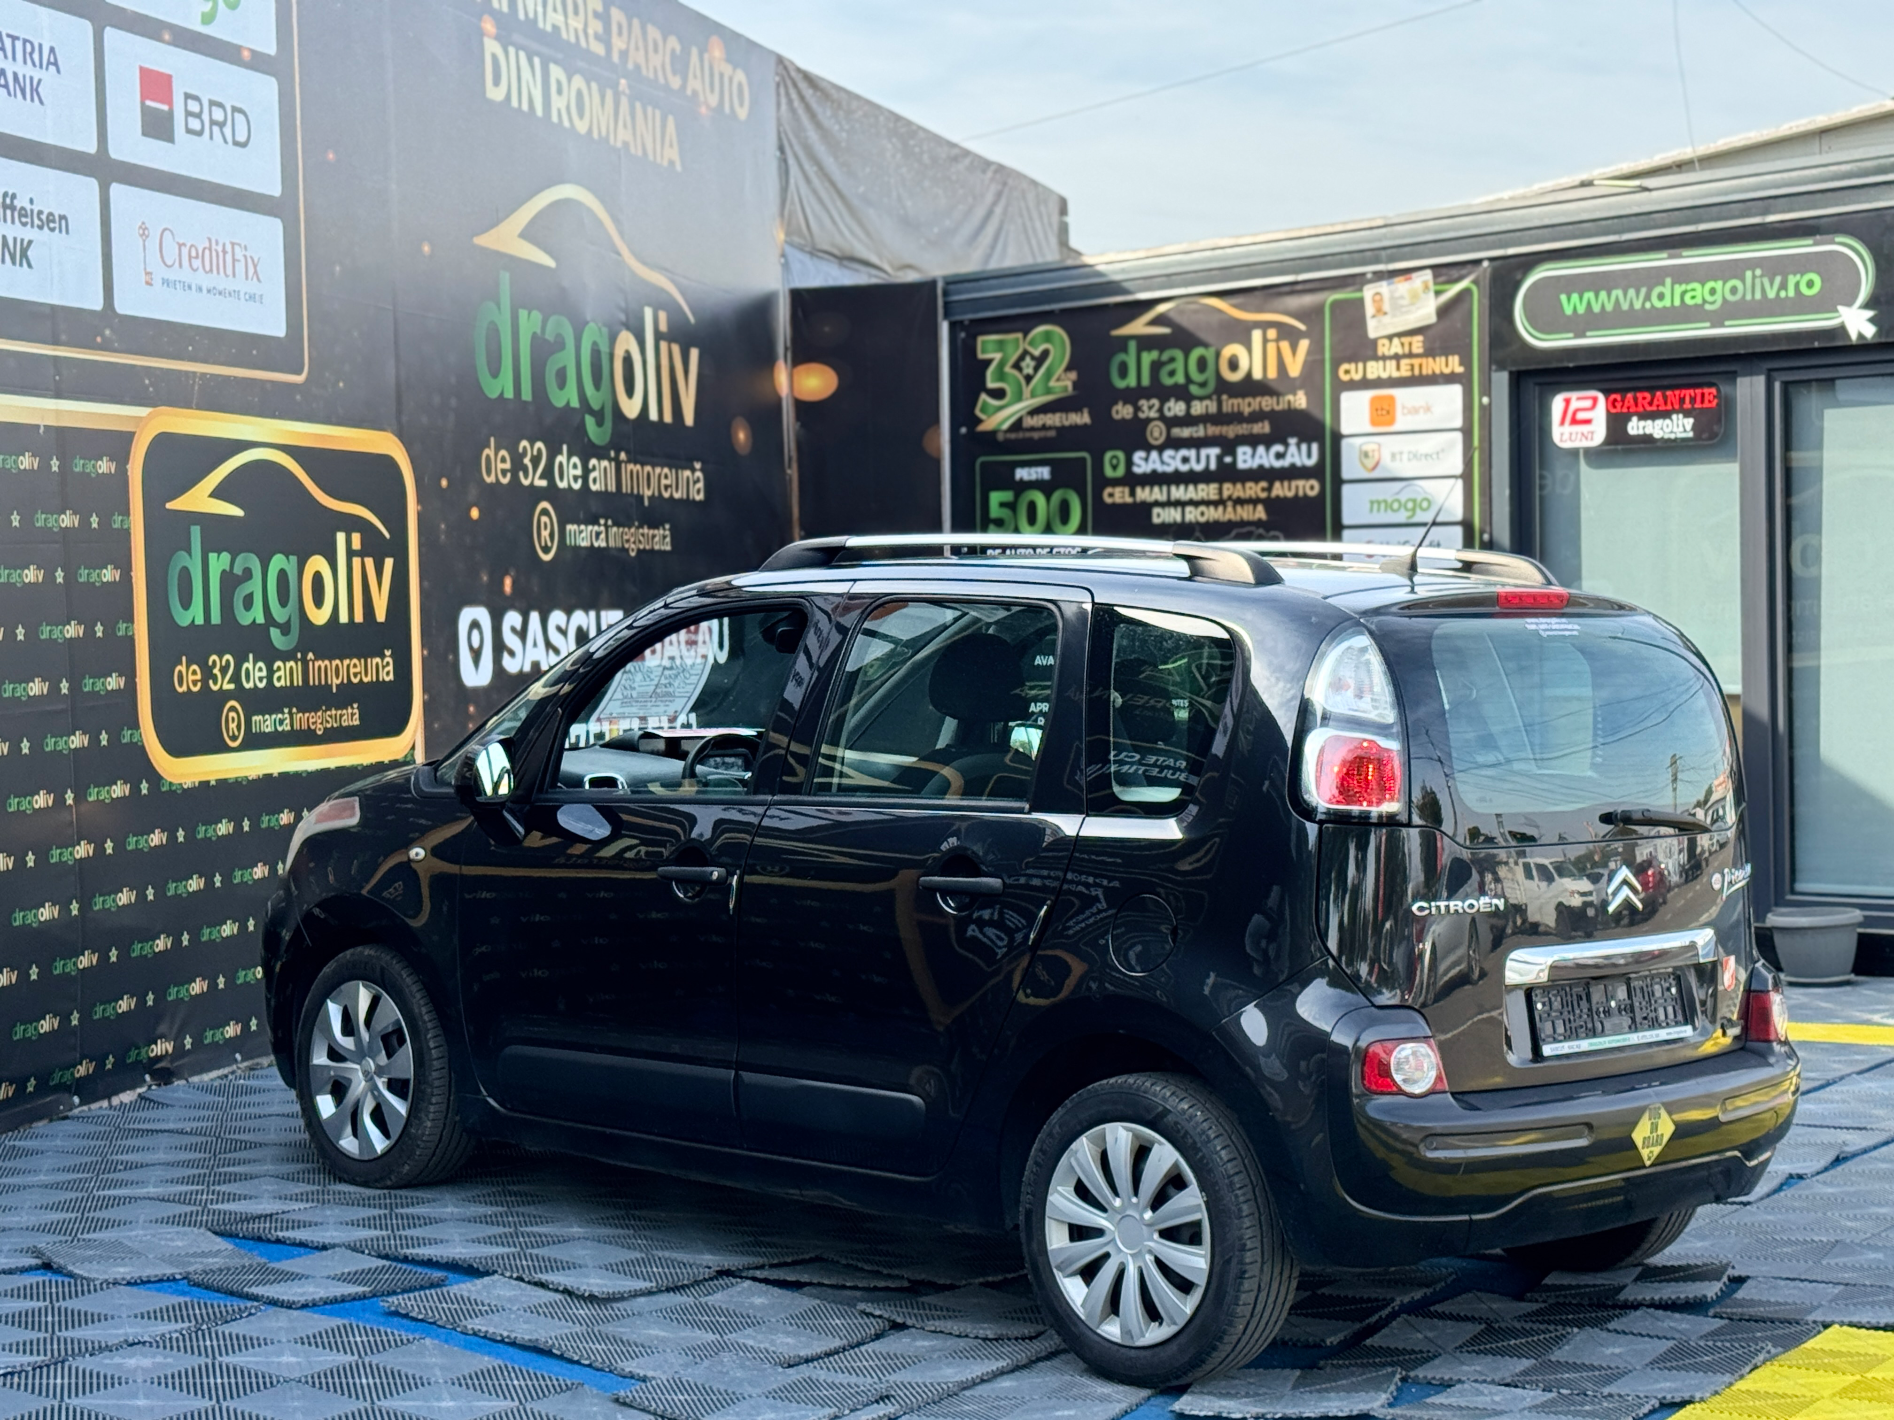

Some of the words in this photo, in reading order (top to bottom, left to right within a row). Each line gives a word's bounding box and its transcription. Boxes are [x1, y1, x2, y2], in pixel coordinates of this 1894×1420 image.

[610, 6, 681, 90] PARC
[686, 45, 750, 121] AUTO
[183, 91, 251, 149] BRD
[483, 36, 543, 118] DIN
[549, 78, 682, 173] ROMÂNIA
[159, 227, 262, 284] CreditFix
[161, 277, 192, 292] PRIETEN
[206, 286, 241, 301] MOMENTE
[1560, 268, 1822, 316] www.dragoliv.ro
[474, 270, 700, 446] dragoliv
[1377, 335, 1425, 356] RATE
[974, 324, 1072, 422] 32
[1110, 328, 1310, 396] dragoliv
[1338, 362, 1363, 382] CU
[1365, 355, 1465, 381] BULETINUL
[1111, 400, 1134, 420] de
[1137, 398, 1160, 418] 32
[1163, 398, 1187, 417] de
[1190, 396, 1217, 415] ani
[1221, 390, 1308, 416] împreună
[1401, 401, 1433, 416] bank
[1559, 395, 1599, 427] 12
[1607, 387, 1718, 413] GARANTIE
[1559, 430, 1596, 443] LUNI
[1627, 413, 1695, 439] dragoliv
[73, 455, 116, 477] dragoliv
[1132, 446, 1220, 474] SASCUT
[1236, 437, 1319, 470] BACĂU
[481, 437, 511, 484] de
[519, 440, 548, 486] 32
[554, 444, 583, 490] de
[588, 450, 616, 493] ani
[620, 452, 705, 506] împreună
[1014, 466, 1051, 481] PESTE
[1103, 486, 1134, 504] CEL
[1135, 485, 1167, 502] MAI
[1170, 483, 1220, 501] MARE
[1222, 481, 1268, 500] PARC
[1270, 478, 1320, 498] AUTO
[34, 509, 80, 532] dragoliv
[987, 488, 1082, 535] 500
[1152, 506, 1182, 524] DIN
[1184, 501, 1267, 524] ROMÂNIA
[1368, 497, 1431, 520] mogo
[566, 518, 607, 548] marcă
[77, 565, 121, 586] dragoliv
[167, 525, 394, 650] dragoliv
[39, 620, 84, 643] dragoliv
[2, 677, 49, 700] dragoliv
[82, 672, 125, 695] dragoliv
[173, 656, 202, 694] de
[208, 653, 235, 691] 32
[241, 653, 267, 690] de
[273, 652, 302, 688] ani
[307, 649, 394, 693] împreună
[251, 708, 291, 733] marcă
[293, 703, 360, 735] înregistrată
[44, 730, 89, 754] dragoliv
[6, 790, 54, 814] dragoliv
[86, 780, 131, 803] dragoliv
[49, 840, 94, 864] dragoliv
[126, 828, 167, 850] dragoliv
[196, 818, 235, 841] dragoliv
[260, 808, 295, 830] dragoliv
[11, 902, 60, 928] dragoliv
[91, 887, 137, 911] dragoliv
[166, 874, 205, 897] dragoliv
[232, 862, 269, 884] dragoliv
[52, 950, 98, 975] dragoliv
[130, 934, 173, 957] dragoliv
[200, 920, 239, 942] dragoliv
[12, 1013, 60, 1040] dragoliv
[92, 994, 137, 1019] dragoliv
[166, 976, 208, 1001] dragoliv
[203, 1021, 242, 1044] dragoliv
